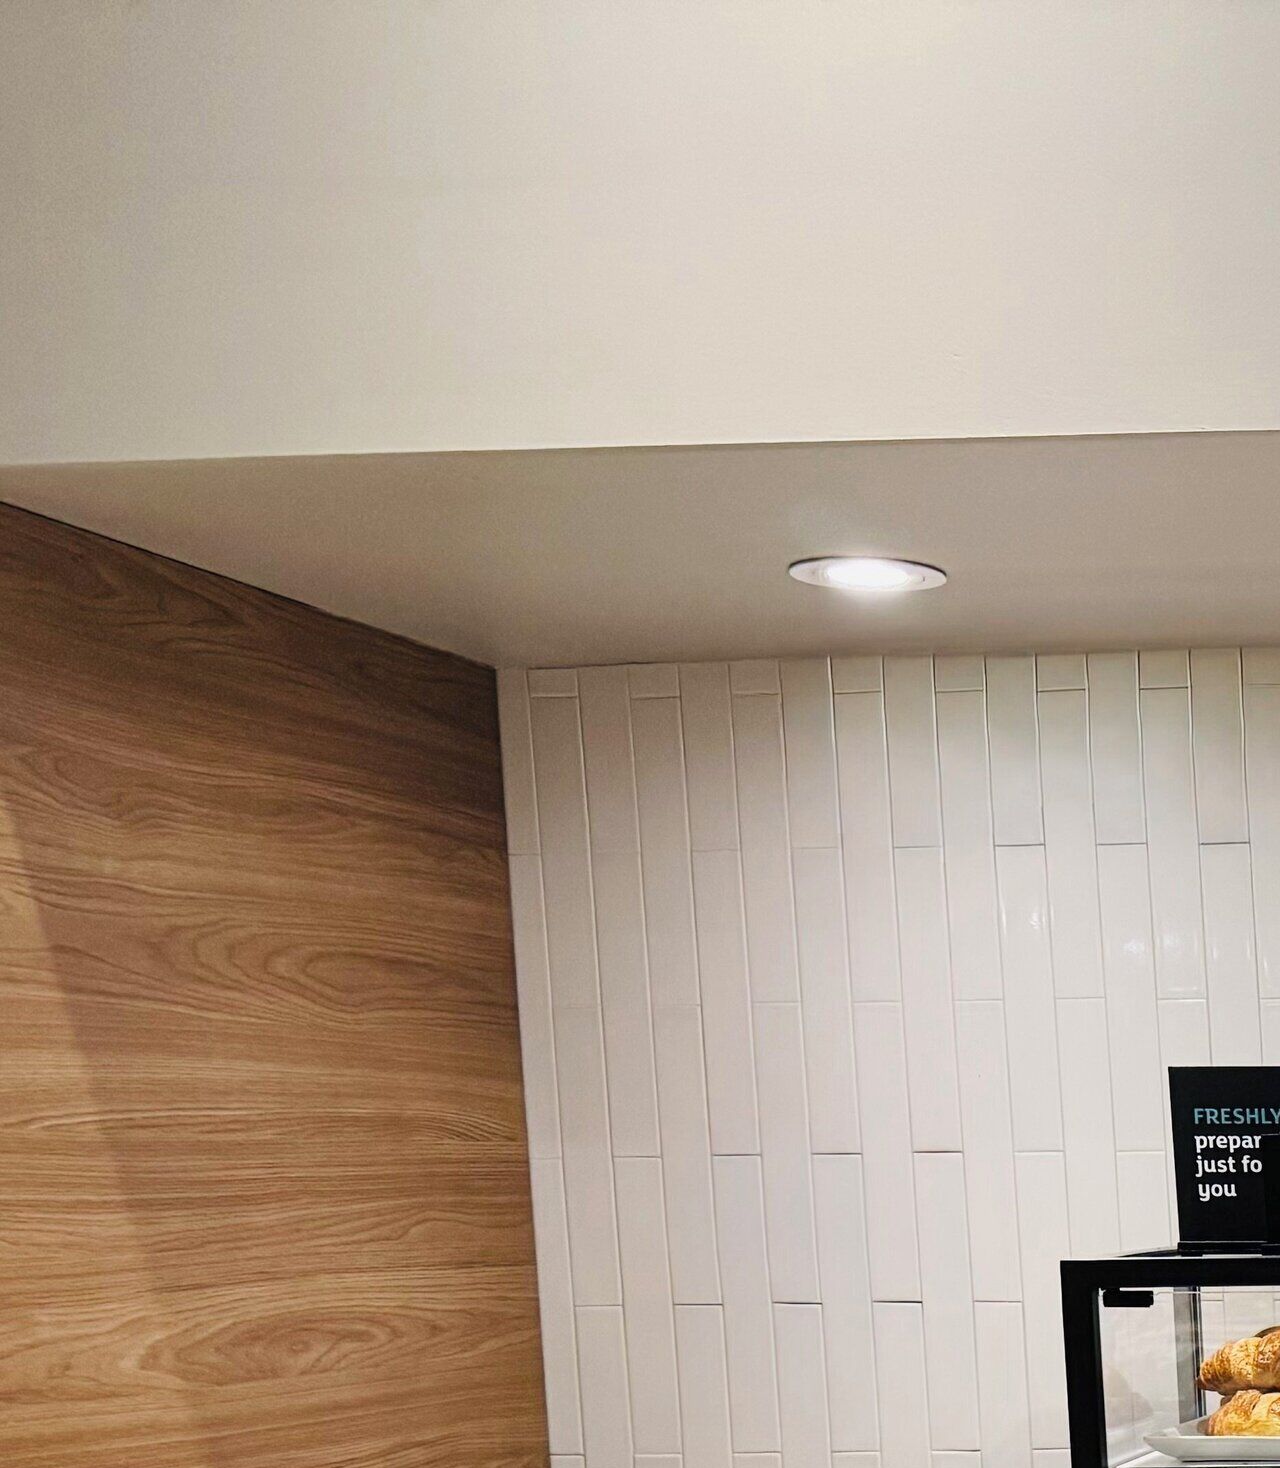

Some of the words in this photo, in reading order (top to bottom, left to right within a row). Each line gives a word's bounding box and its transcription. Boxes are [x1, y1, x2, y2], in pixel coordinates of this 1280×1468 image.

[1194, 1135, 1262, 1153] prepar
[1195, 1155, 1237, 1178] just
[1241, 1155, 1263, 1173] fo
[1198, 1183, 1237, 1202] you
